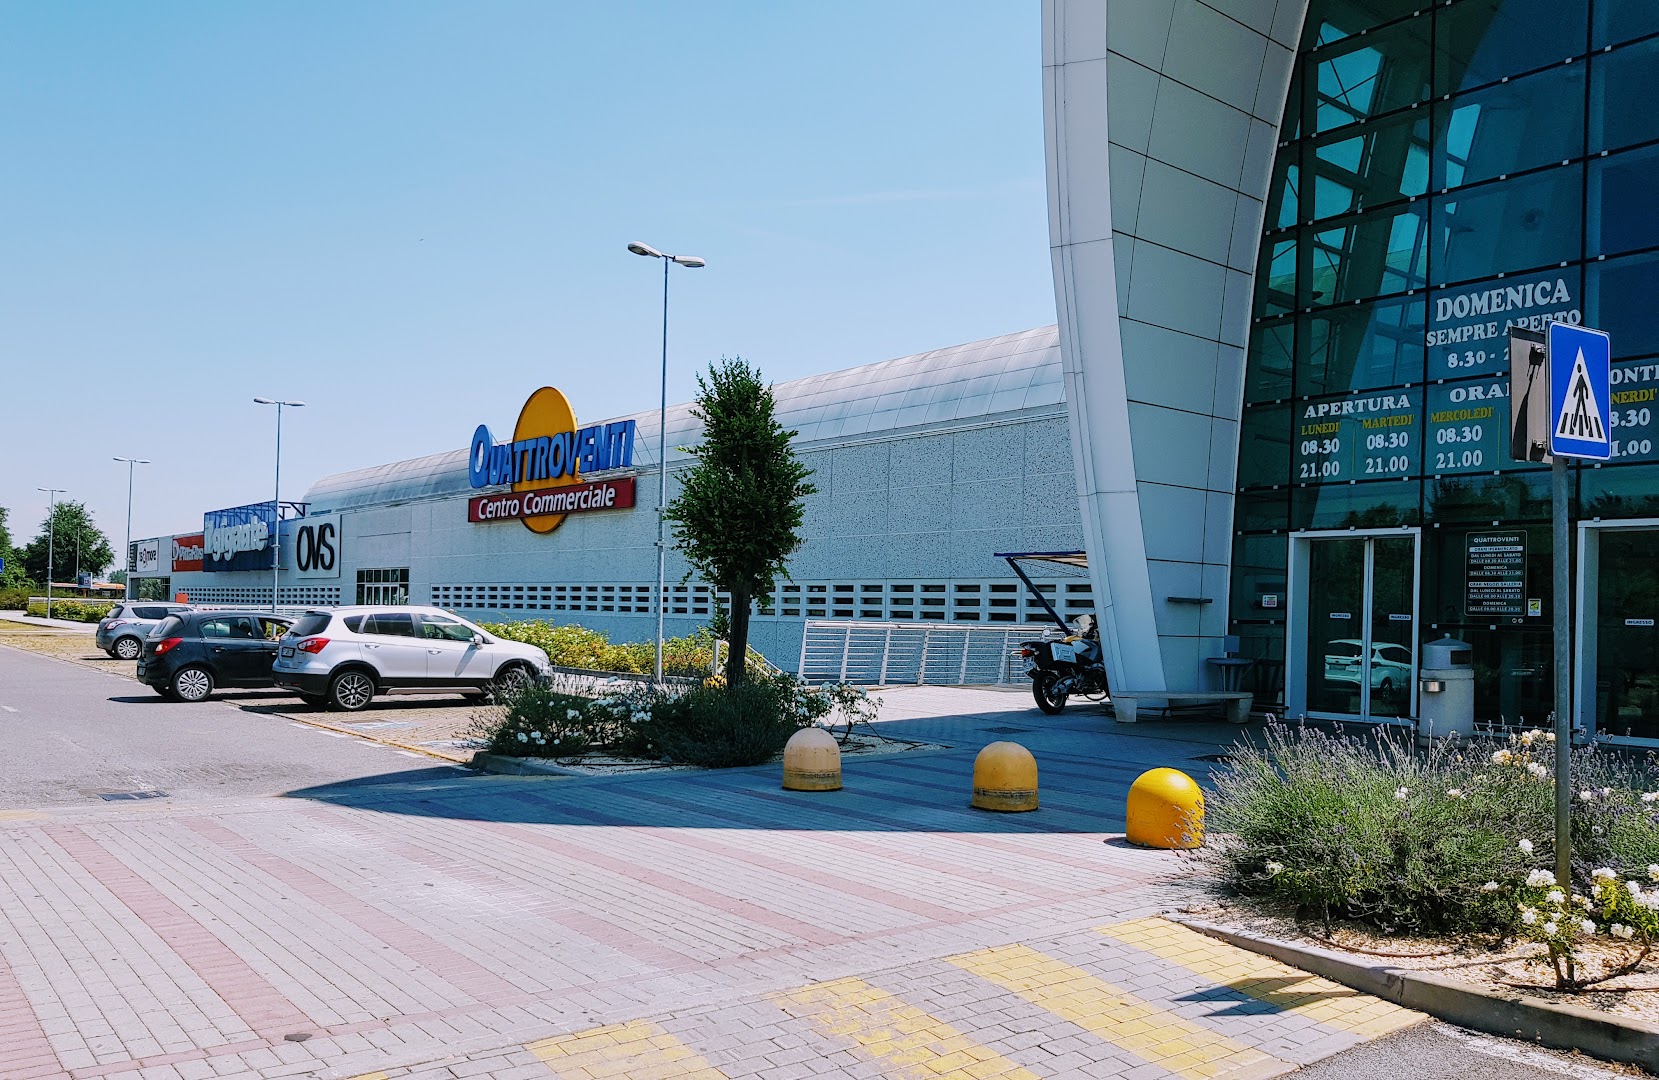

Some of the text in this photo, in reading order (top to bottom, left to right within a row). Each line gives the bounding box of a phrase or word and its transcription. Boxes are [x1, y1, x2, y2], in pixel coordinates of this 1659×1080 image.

[1436, 278, 1571, 322] DOMENICA
[1426, 321, 1498, 347] SEMPRE
[1447, 350, 1486, 368] 8.30
[1303, 394, 1410, 419] APERTURA
[1450, 383, 1510, 403] ORA
[1301, 407, 1651, 456] 08.30 08.30 08.30 8.30
[469, 419, 636, 489] QUATTROVENTI
[1300, 439, 1652, 479] 21.00 21.00 21.00 1.00
[478, 483, 616, 520] Centro Commerciale
[296, 522, 335, 572] OVS
